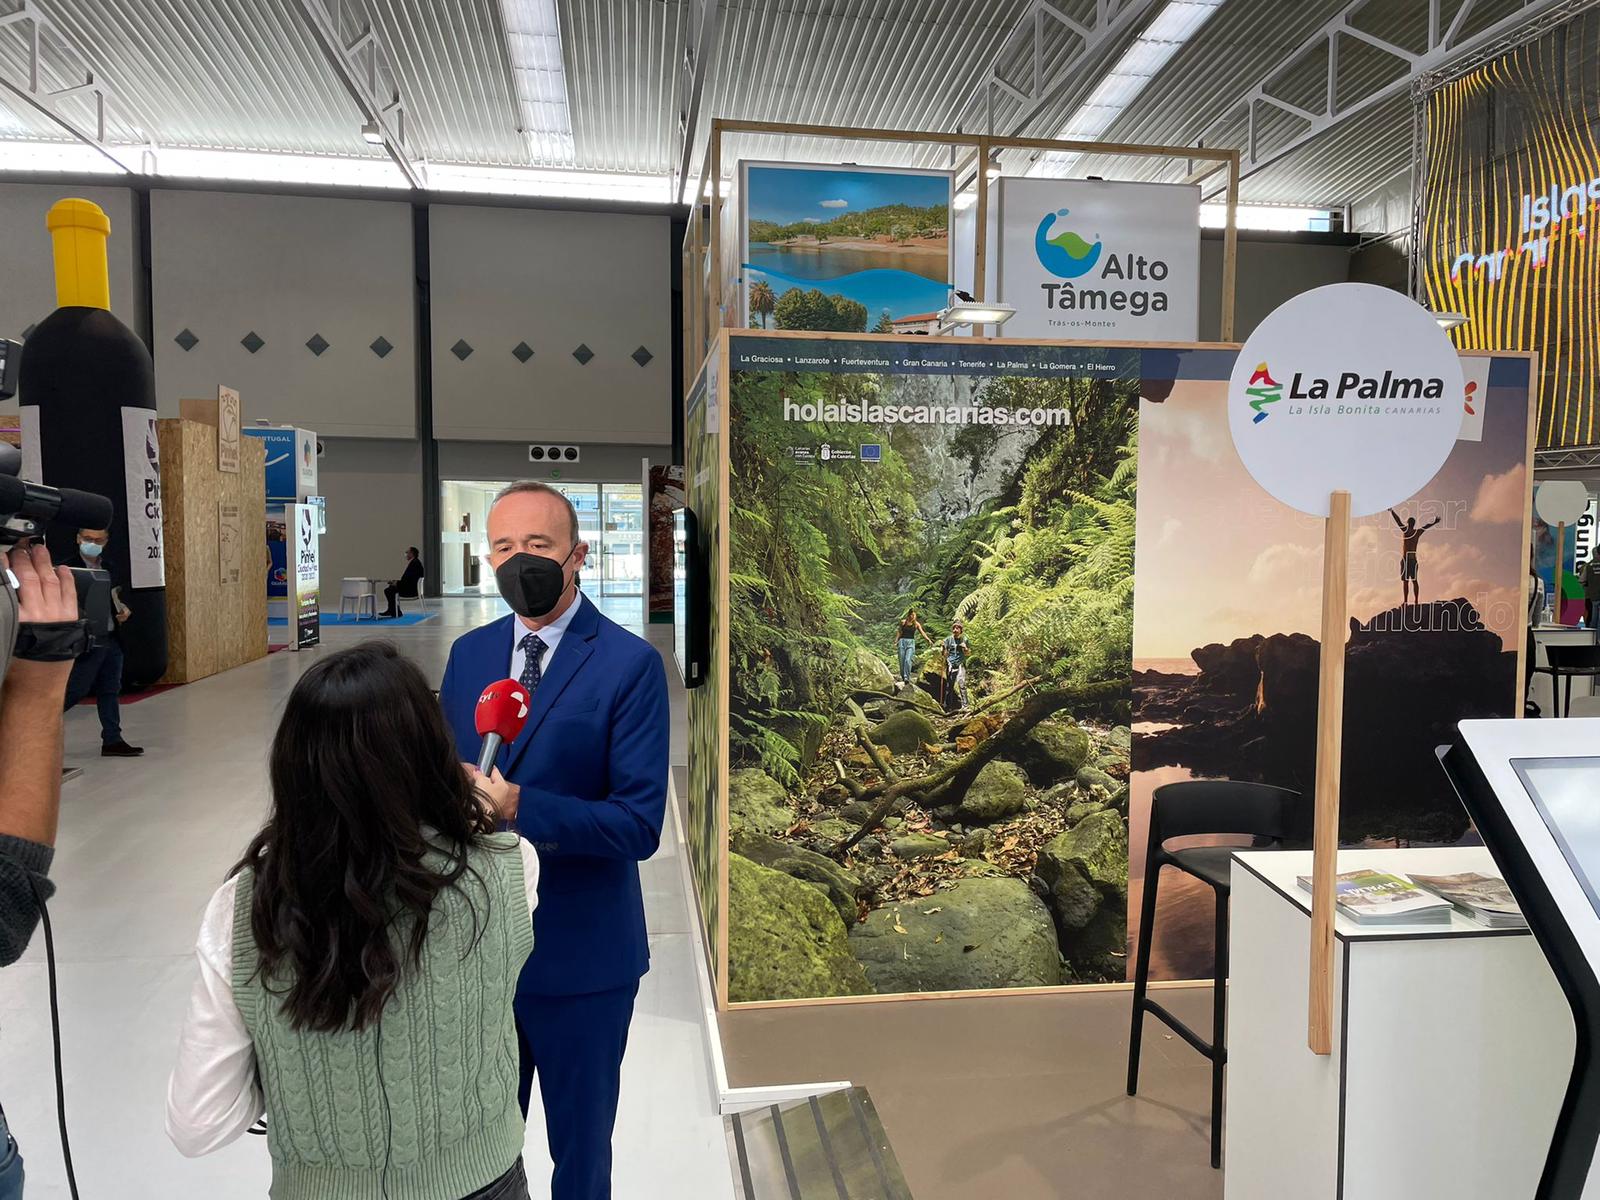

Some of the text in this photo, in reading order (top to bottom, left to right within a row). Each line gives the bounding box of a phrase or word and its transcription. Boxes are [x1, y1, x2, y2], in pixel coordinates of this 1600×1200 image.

[1101, 253, 1168, 281] Alto
[1041, 281, 1168, 316] Tâmega
[740, 354, 750, 362] La
[751, 354, 784, 364] Graciosa
[794, 356, 830, 364] Lanzarote
[841, 357, 890, 366] Fuerteventura
[902, 358, 921, 367] Gran
[922, 359, 948, 368] Canaria
[958, 359, 986, 368] Tenerife
[996, 360, 1006, 369] La
[1007, 360, 1029, 370] Palma
[1039, 361, 1048, 370] La
[1049, 362, 1077, 370] Gomera
[1096, 363, 1116, 371] Hierro
[1289, 370, 1444, 400] La Palma
[783, 397, 1070, 426] holaislascanarias.com
[1289, 404, 1442, 415] La Isla Bonita CANARIAS
[1359, 592, 1515, 632] mundo
